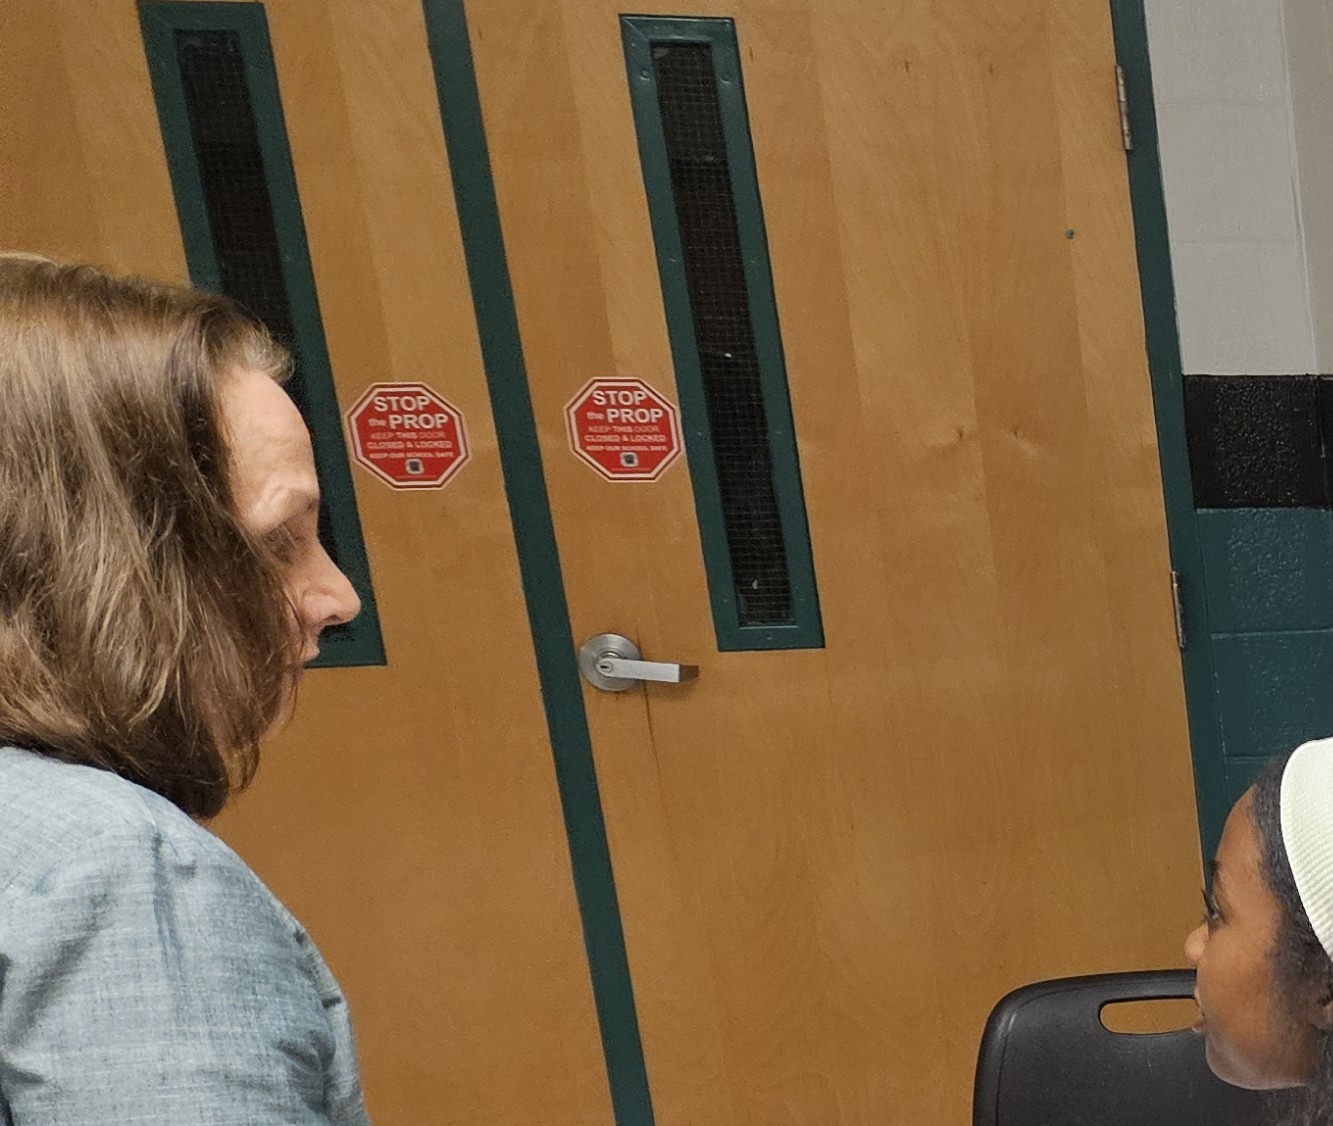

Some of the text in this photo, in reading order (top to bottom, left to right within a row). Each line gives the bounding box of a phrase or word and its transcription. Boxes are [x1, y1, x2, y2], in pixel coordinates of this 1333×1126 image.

[373, 395, 431, 412] STOP
[592, 390, 647, 406] STOP
[388, 413, 449, 430] PROP
[606, 408, 664, 423] PROP
[366, 441, 406, 449] CLOSED
[414, 440, 452, 449] LOCKED
[584, 434, 621, 442] CLOSED
[630, 434, 666, 442] LOCKED
